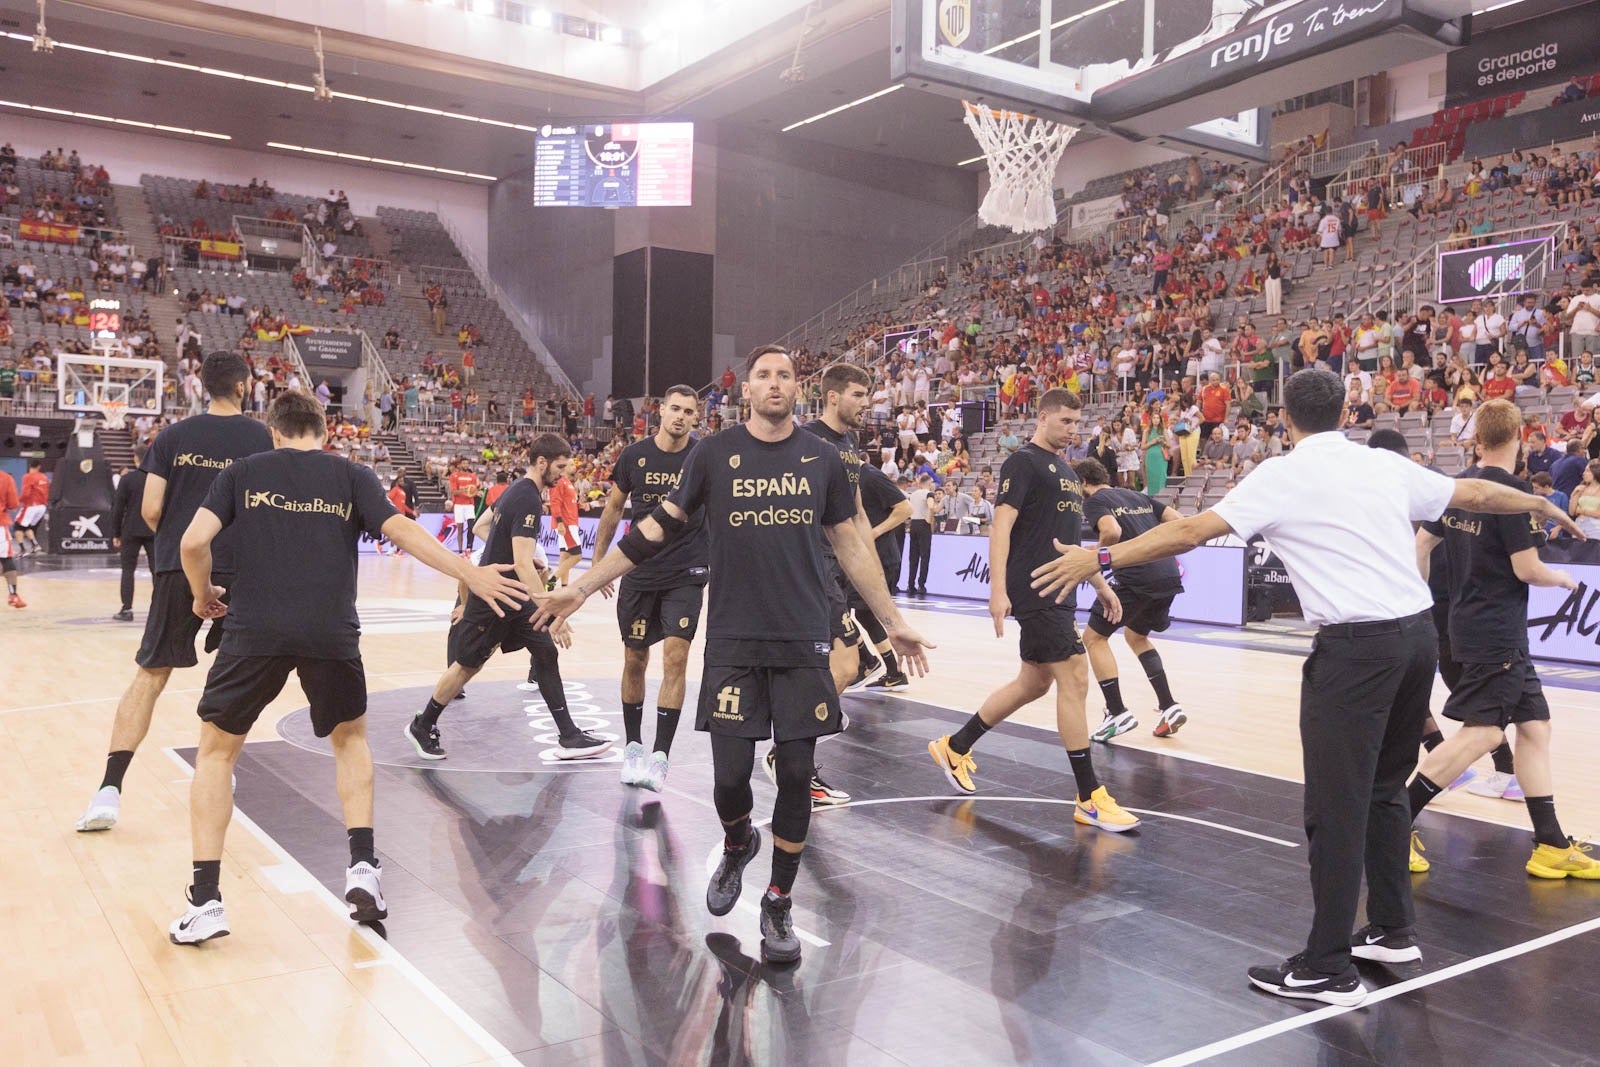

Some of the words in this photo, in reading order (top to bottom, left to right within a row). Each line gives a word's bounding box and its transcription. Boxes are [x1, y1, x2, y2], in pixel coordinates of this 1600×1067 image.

[1210, 16, 1294, 68] renfe
[1302, 7, 1329, 37] Tu
[1478, 42, 1558, 72] Granada
[1477, 74, 1494, 86] es
[1496, 58, 1557, 82] deporte
[732, 472, 811, 497] ESPAÑA
[270, 494, 347, 517] CaixaBank
[729, 505, 813, 527] endesa
[1527, 581, 1600, 645] AL
[717, 685, 741, 714] fi
[713, 710, 745, 721] network
